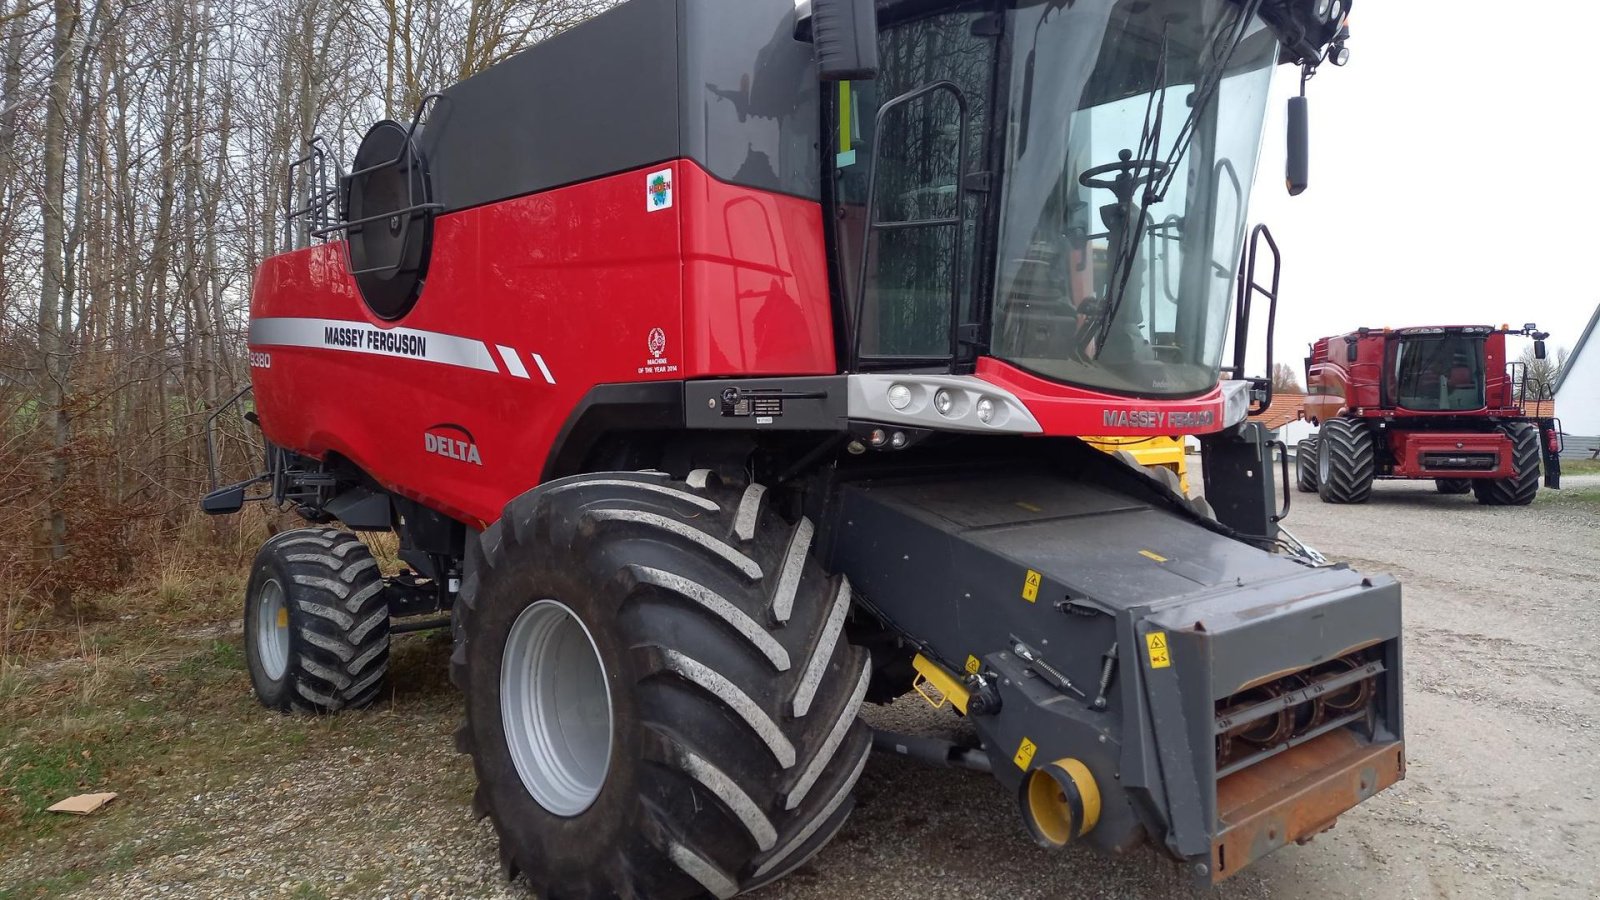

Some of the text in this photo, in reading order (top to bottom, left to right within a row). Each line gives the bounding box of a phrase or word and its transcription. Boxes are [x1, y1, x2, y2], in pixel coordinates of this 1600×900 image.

[324, 326, 426, 357] MASSEY FERGUSON
[250, 352, 271, 369] 9380
[1103, 410, 1214, 428] MASSEY FERGUSO
[424, 432, 483, 466] DELTA
